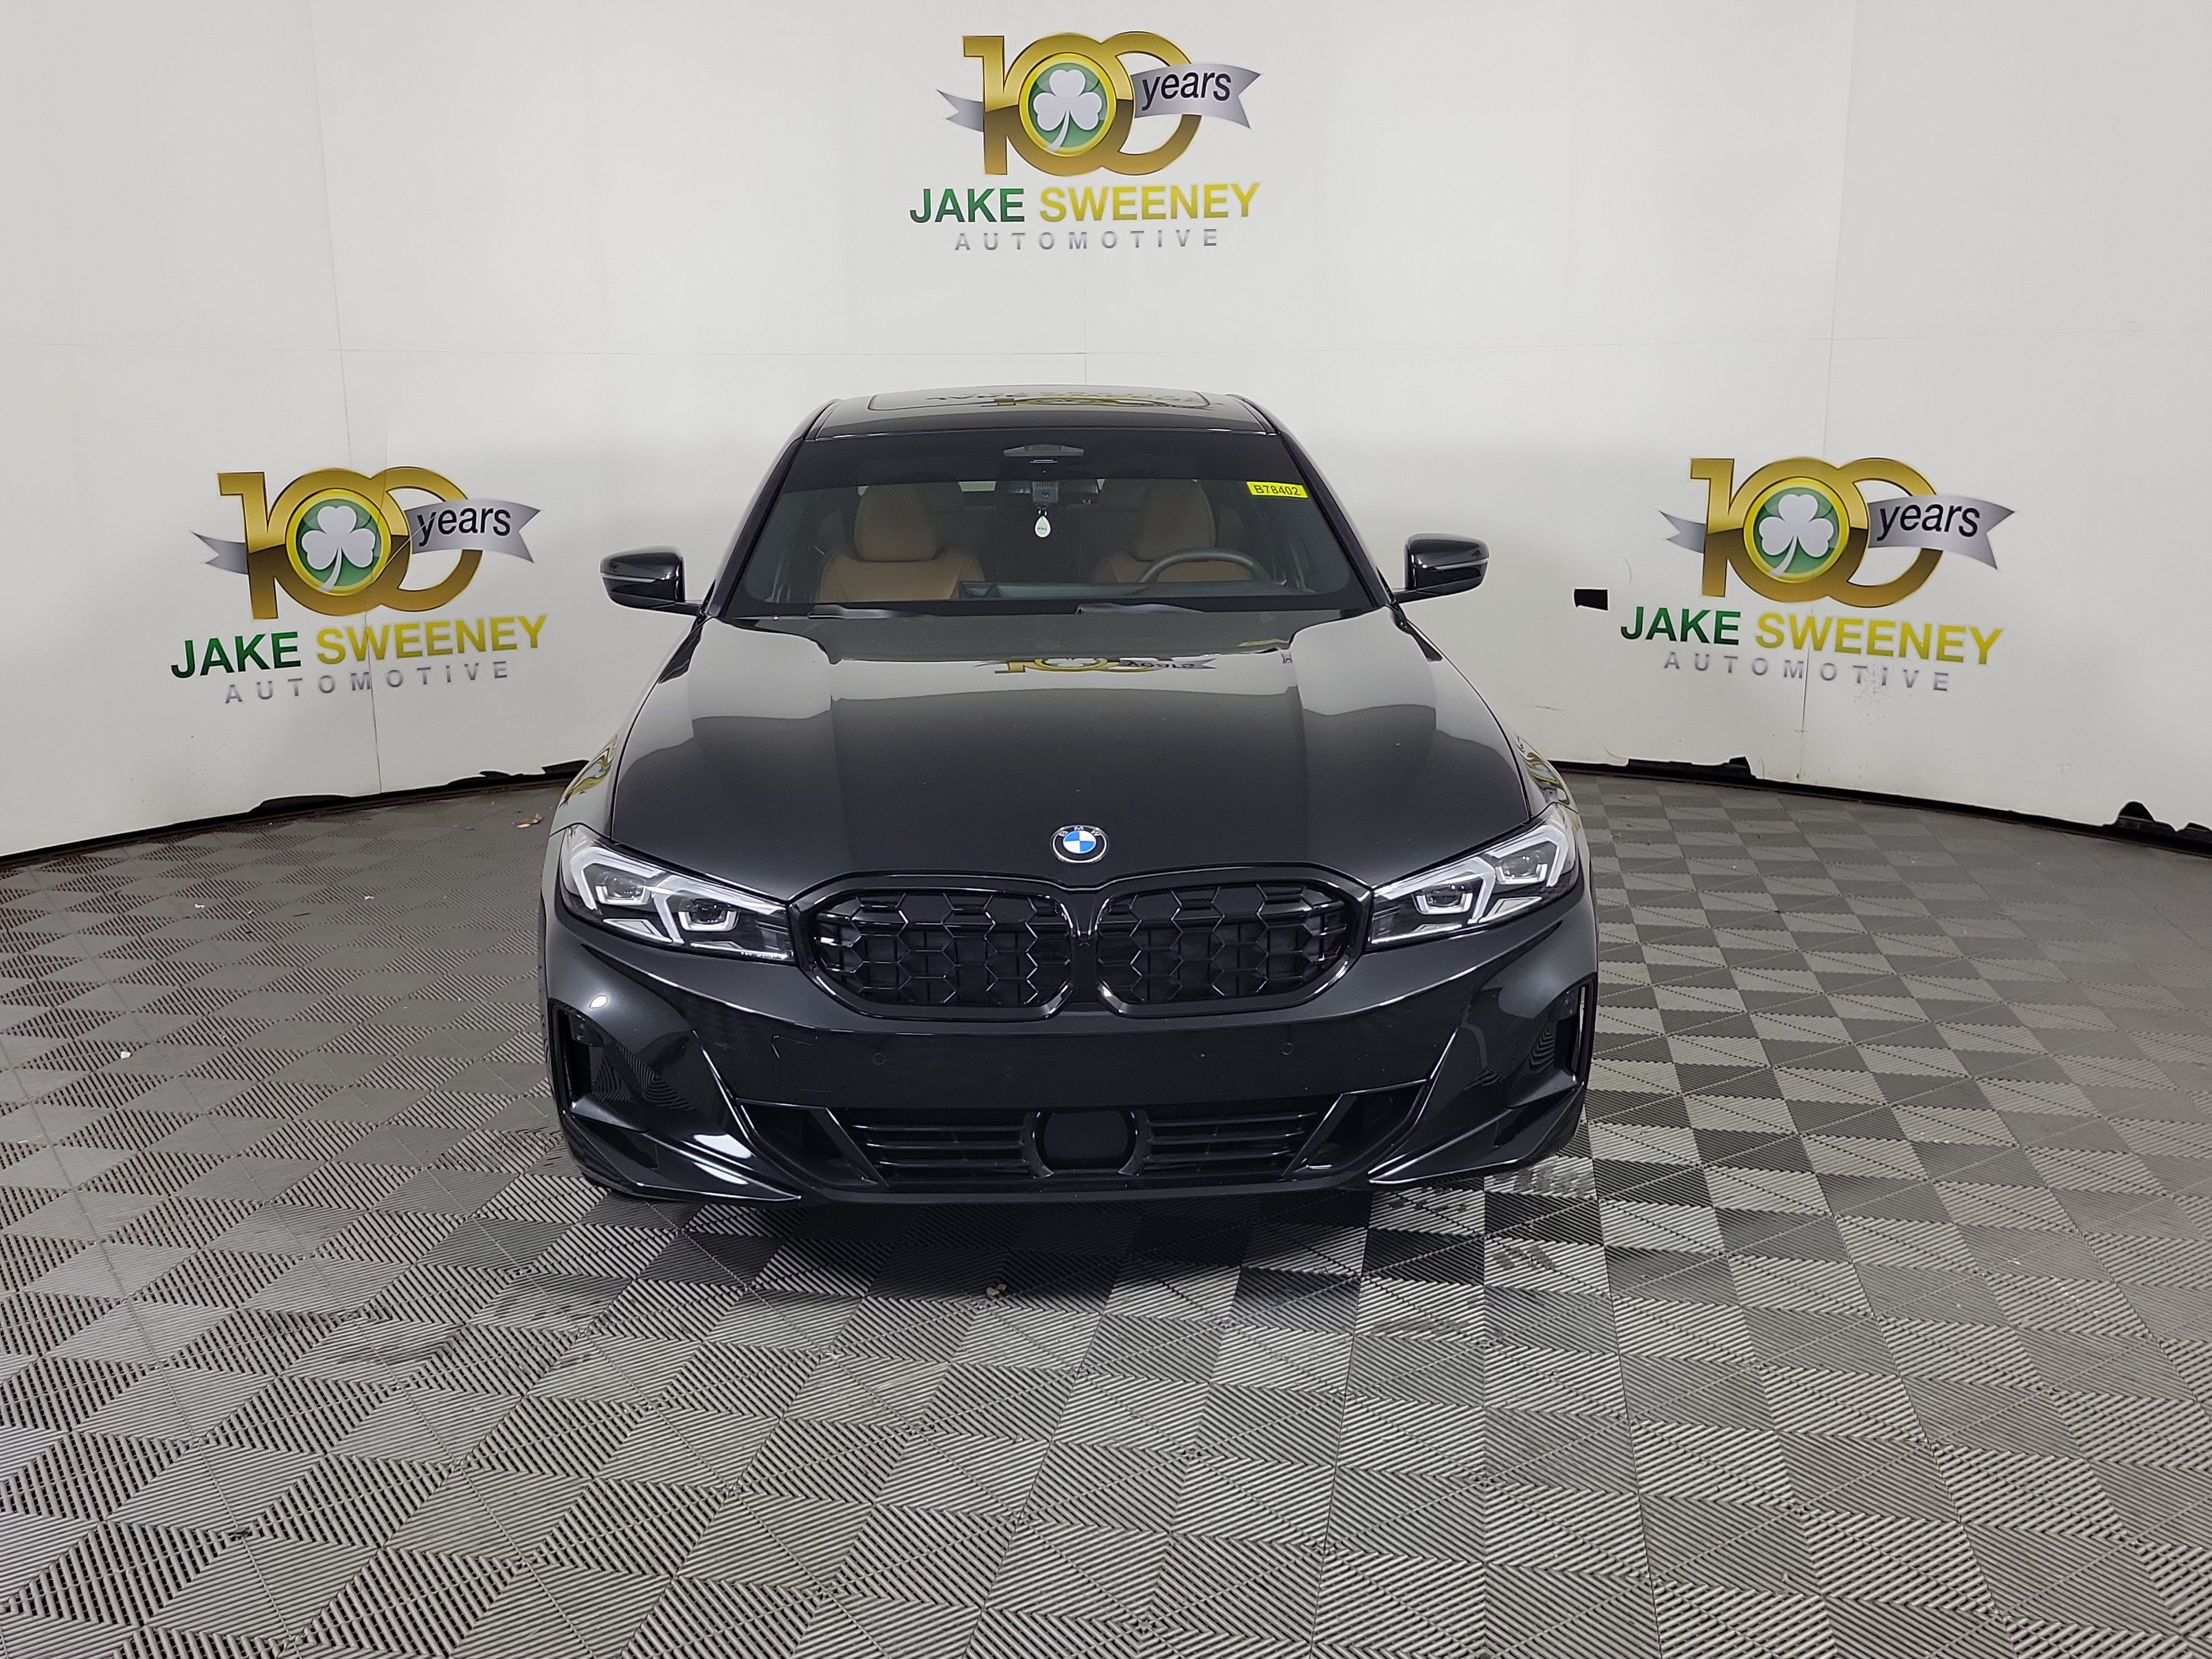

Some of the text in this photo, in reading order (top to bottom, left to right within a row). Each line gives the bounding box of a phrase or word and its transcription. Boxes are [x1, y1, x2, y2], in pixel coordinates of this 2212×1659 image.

[961, 30, 1232, 177] 100 years
[909, 182, 1260, 223] JAKE SWEENEY
[954, 228, 1218, 251] AUTOMOTIVE
[1253, 484, 1301, 496] B78402
[216, 466, 512, 621] 100 years
[1690, 455, 1980, 608] 100 years
[171, 614, 548, 679] JAKE SWEENEY
[1620, 606, 2004, 665] JAKE SWEENEY
[225, 661, 508, 704] AUTOMOTIVE
[1663, 652, 1950, 692] AUTOMOTIVE
[1059, 826, 1102, 837] BMW
